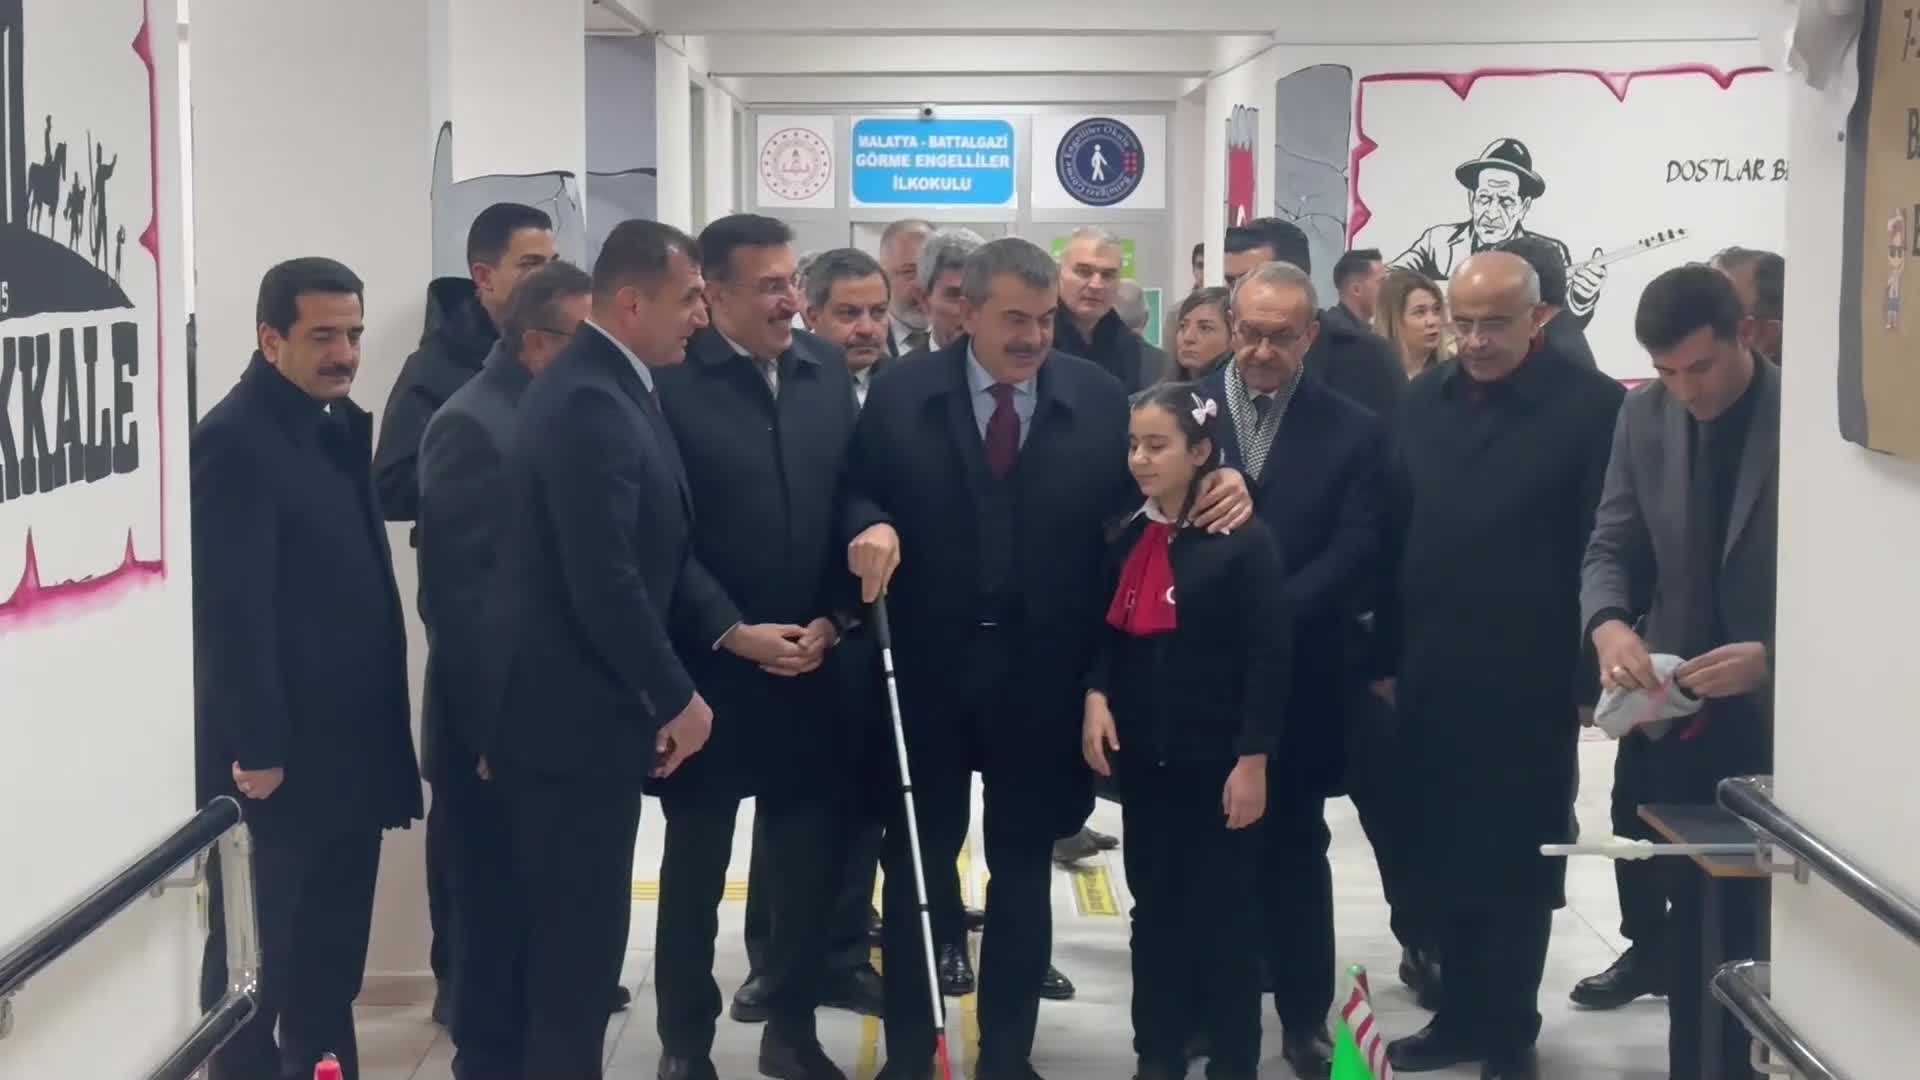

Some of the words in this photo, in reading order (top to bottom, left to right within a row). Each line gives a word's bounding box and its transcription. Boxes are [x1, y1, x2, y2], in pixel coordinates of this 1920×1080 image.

[858, 135, 918, 149] MALATYA
[928, 133, 1009, 149] BATTALGAZİ
[855, 153, 911, 168] GÖRME
[915, 152, 1010, 168] ENGELLİLER
[1666, 158, 1766, 184] DOSTLAR
[892, 174, 973, 191] İLKOKULU
